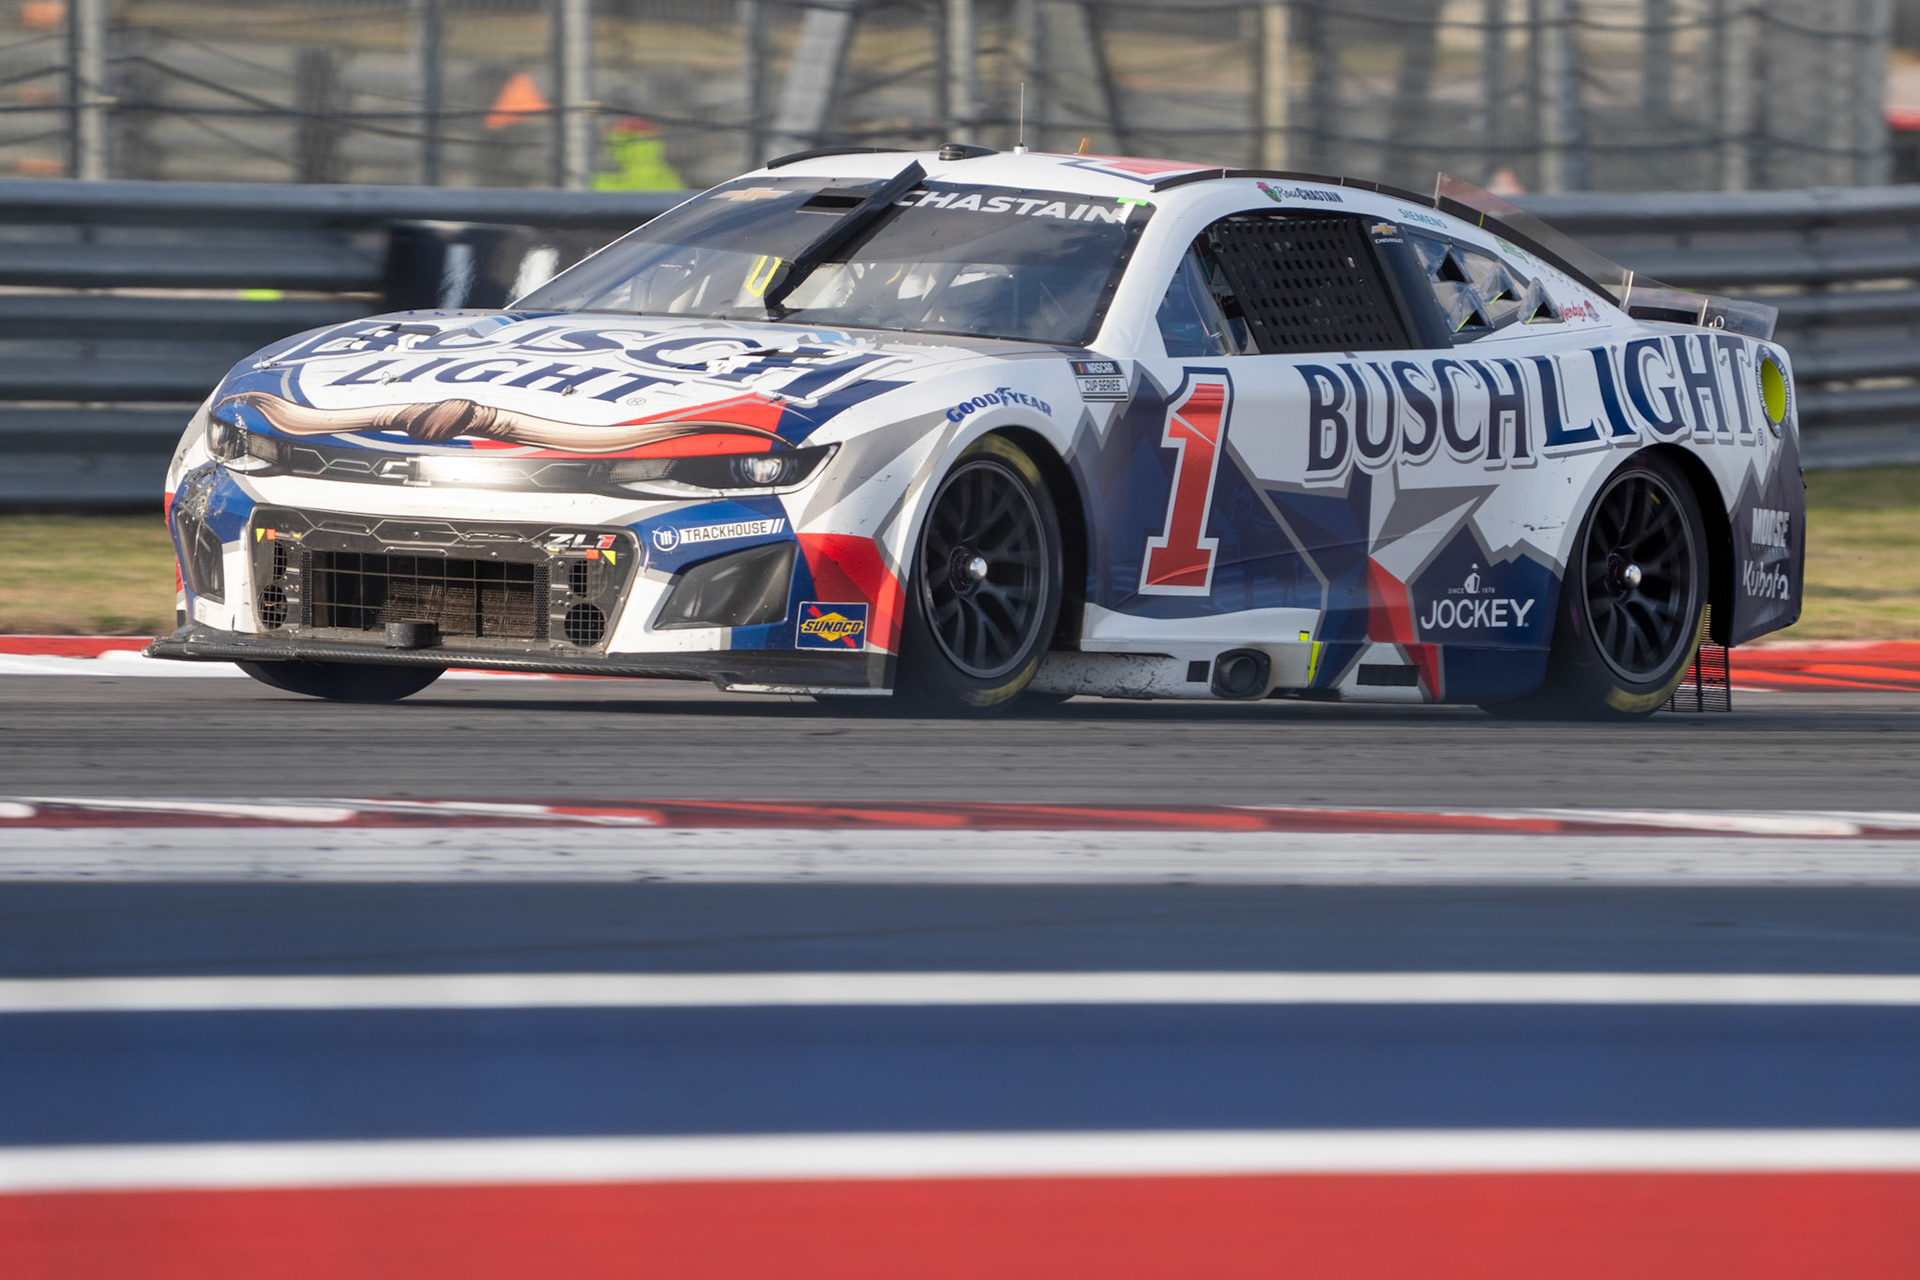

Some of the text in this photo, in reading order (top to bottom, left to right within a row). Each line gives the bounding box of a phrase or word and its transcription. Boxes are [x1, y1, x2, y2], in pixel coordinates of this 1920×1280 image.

[893, 189, 1134, 225] CHASTAIN
[1296, 187, 1343, 203] CHASTAIN
[1398, 208, 1448, 229] SIEMENS
[266, 320, 900, 401] BUSCH
[1086, 362, 1116, 374] NASCAR
[324, 356, 685, 403] LIGHT
[1084, 379, 1121, 391] CUP SERIES
[1292, 334, 1756, 472] BUSCH LIGHT
[1138, 371, 1233, 597] 1
[547, 533, 617, 550] ZL1
[684, 521, 768, 542] TRACKHOUSE
[1752, 508, 1790, 548] MOOSE
[1742, 559, 1789, 600] Kubota
[801, 619, 864, 634] SUNOCO
[1421, 598, 1535, 630] JOCKEY
